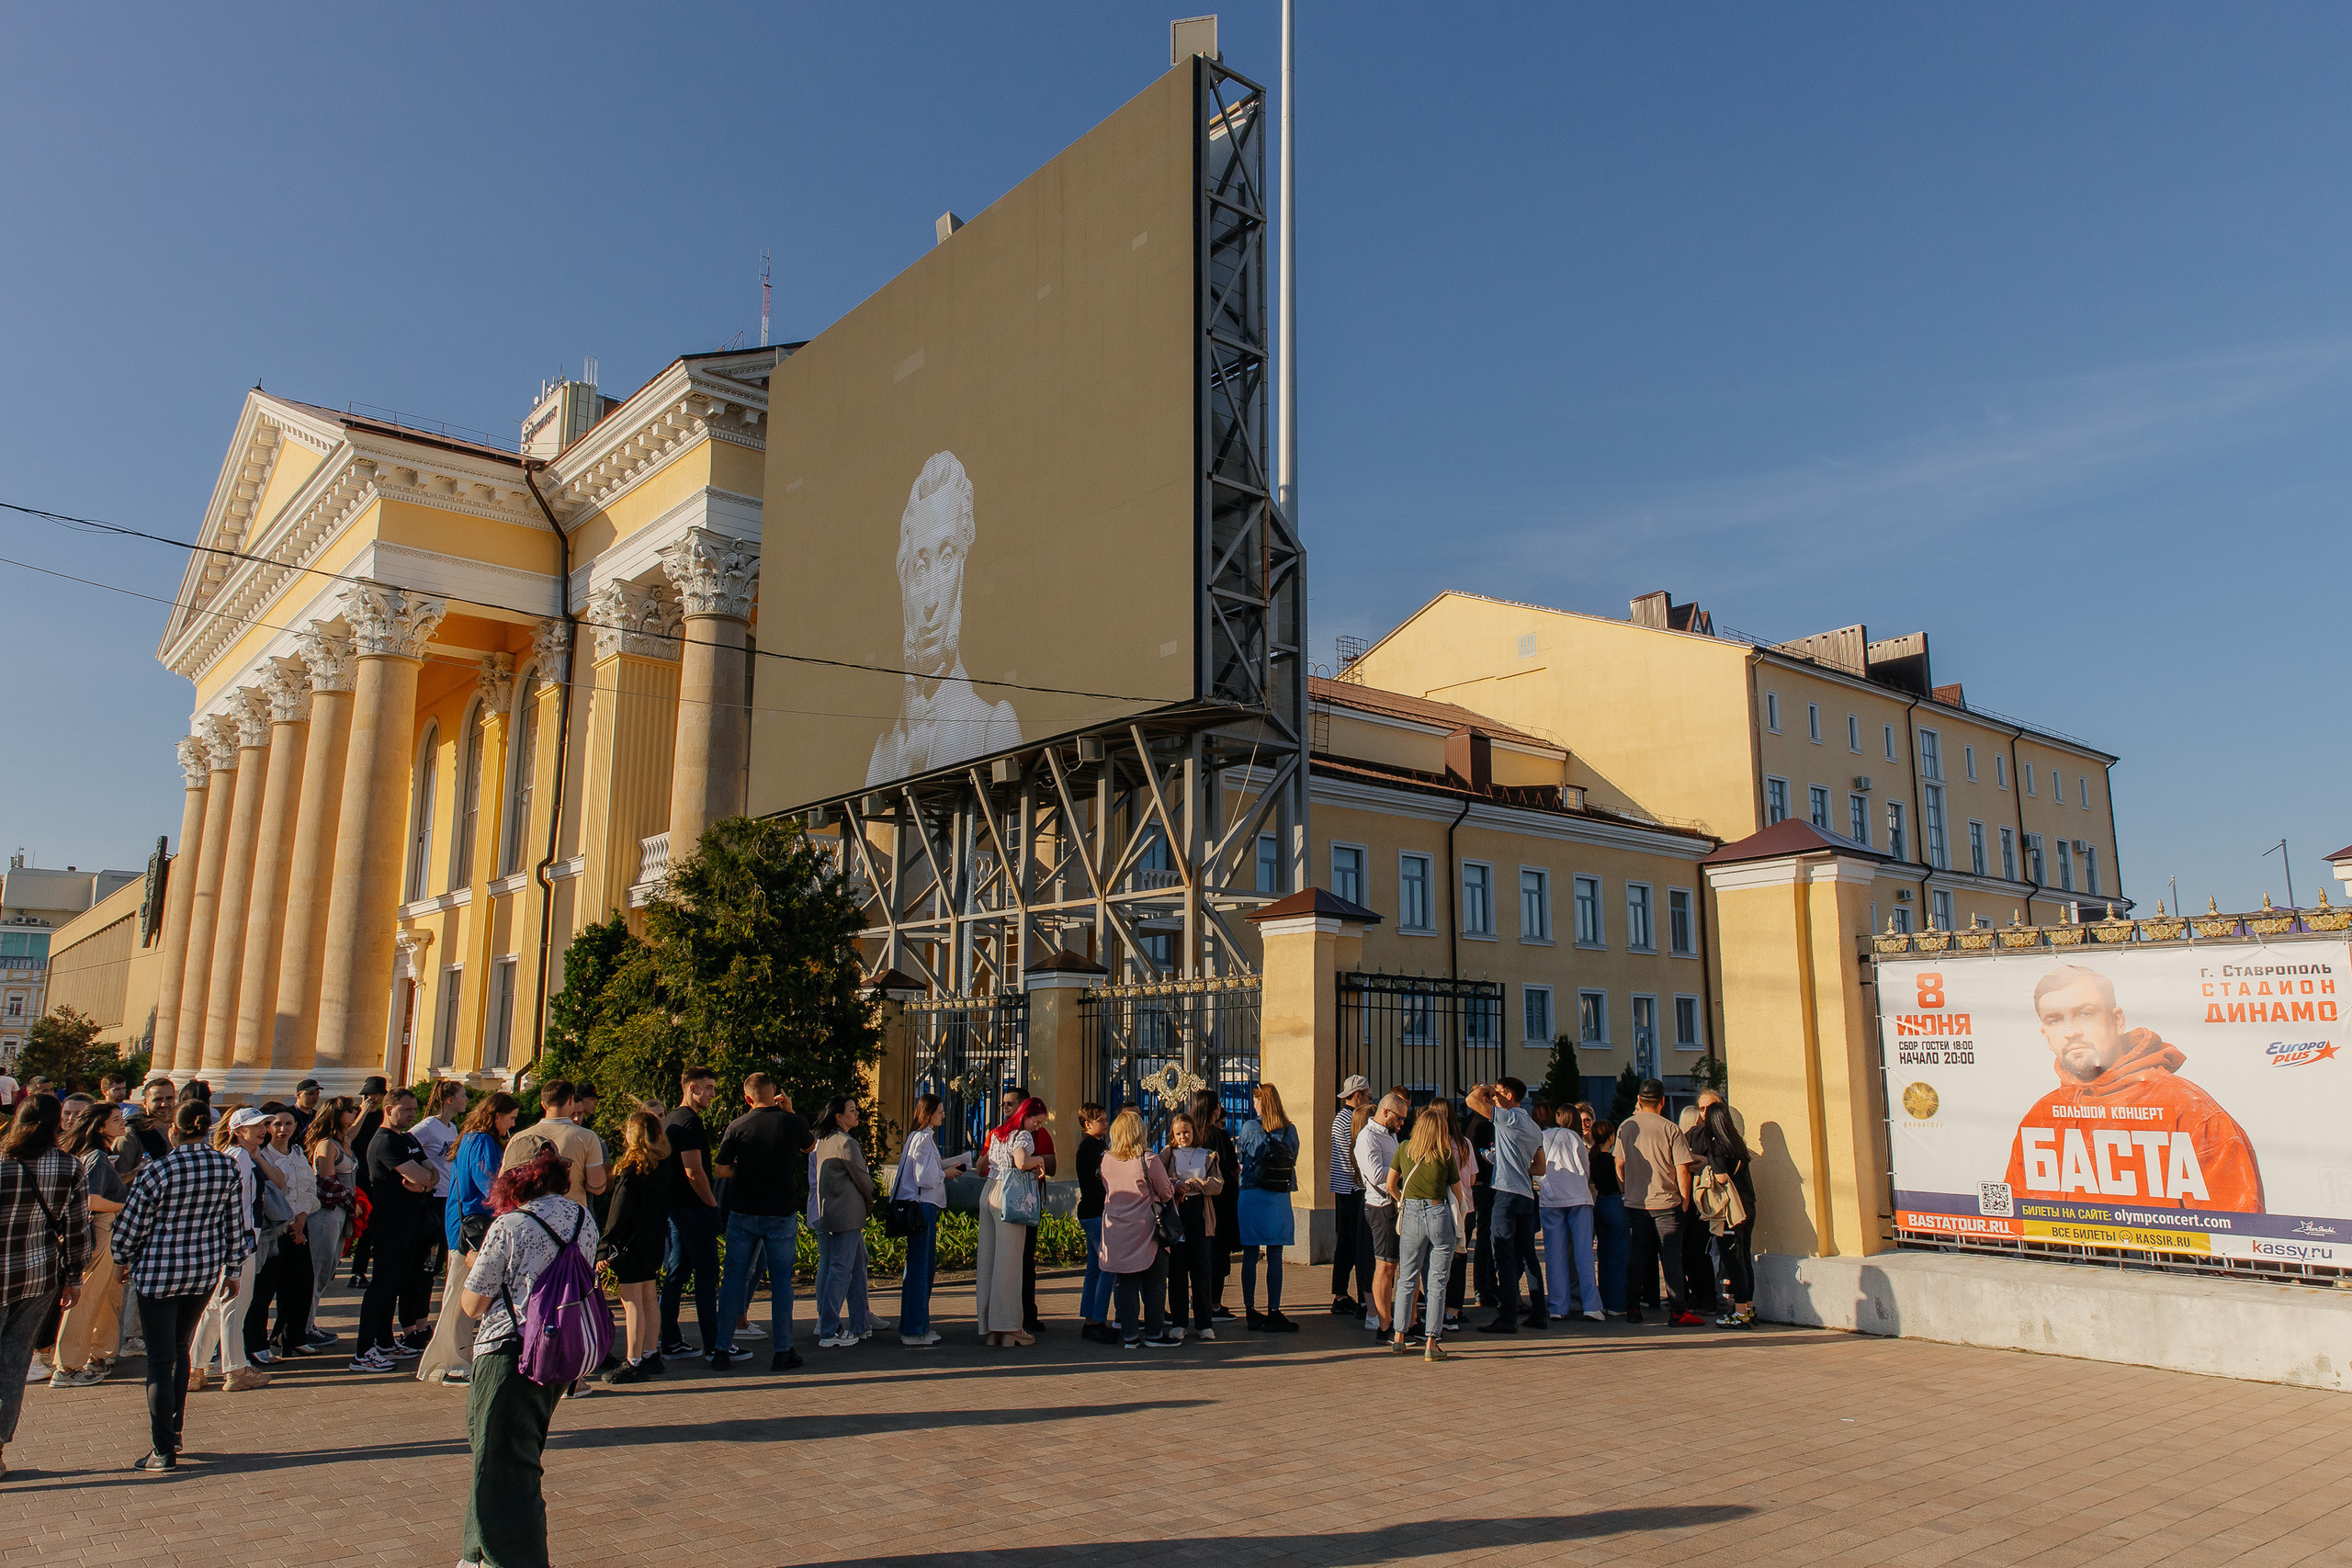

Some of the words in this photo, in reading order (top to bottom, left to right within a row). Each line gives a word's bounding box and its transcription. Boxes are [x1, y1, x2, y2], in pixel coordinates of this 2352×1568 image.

[1917, 973, 1945, 1009] 8
[2201, 979, 2335, 997] СТАДИОН
[2204, 1001, 2337, 1022] ДИНАМО
[1896, 1013, 1972, 1036] ИЮНЯ
[1898, 1041, 1918, 1050] СБОР
[1922, 1040, 1950, 1050] ГОСТЕЙ
[1952, 1041, 1973, 1050] 18:00
[1899, 1052, 1939, 1064] НАЧАЛО
[1944, 1052, 1974, 1064] 20:00
[2052, 1105, 2107, 1119] БОЛЬШОЙ
[2110, 1106, 2165, 1121] КОНЦЕРТ
[2020, 1126, 2211, 1201] БАСТА
[1907, 1213, 2009, 1234] BASTATOUR.RU
[2022, 1204, 2060, 1217] БИЛЕТЫ
[2062, 1208, 2076, 1218] НА
[2078, 1208, 2112, 1221] САЙТЕ:
[2114, 1209, 2232, 1229] olympconcert.com
[2052, 1226, 2071, 1238] ВСЕ
[2073, 1228, 2117, 1241] БИЛЕТЫ
[2136, 1234, 2190, 1247] KASSIR.RU
[2253, 1240, 2333, 1260] kassy.ru
